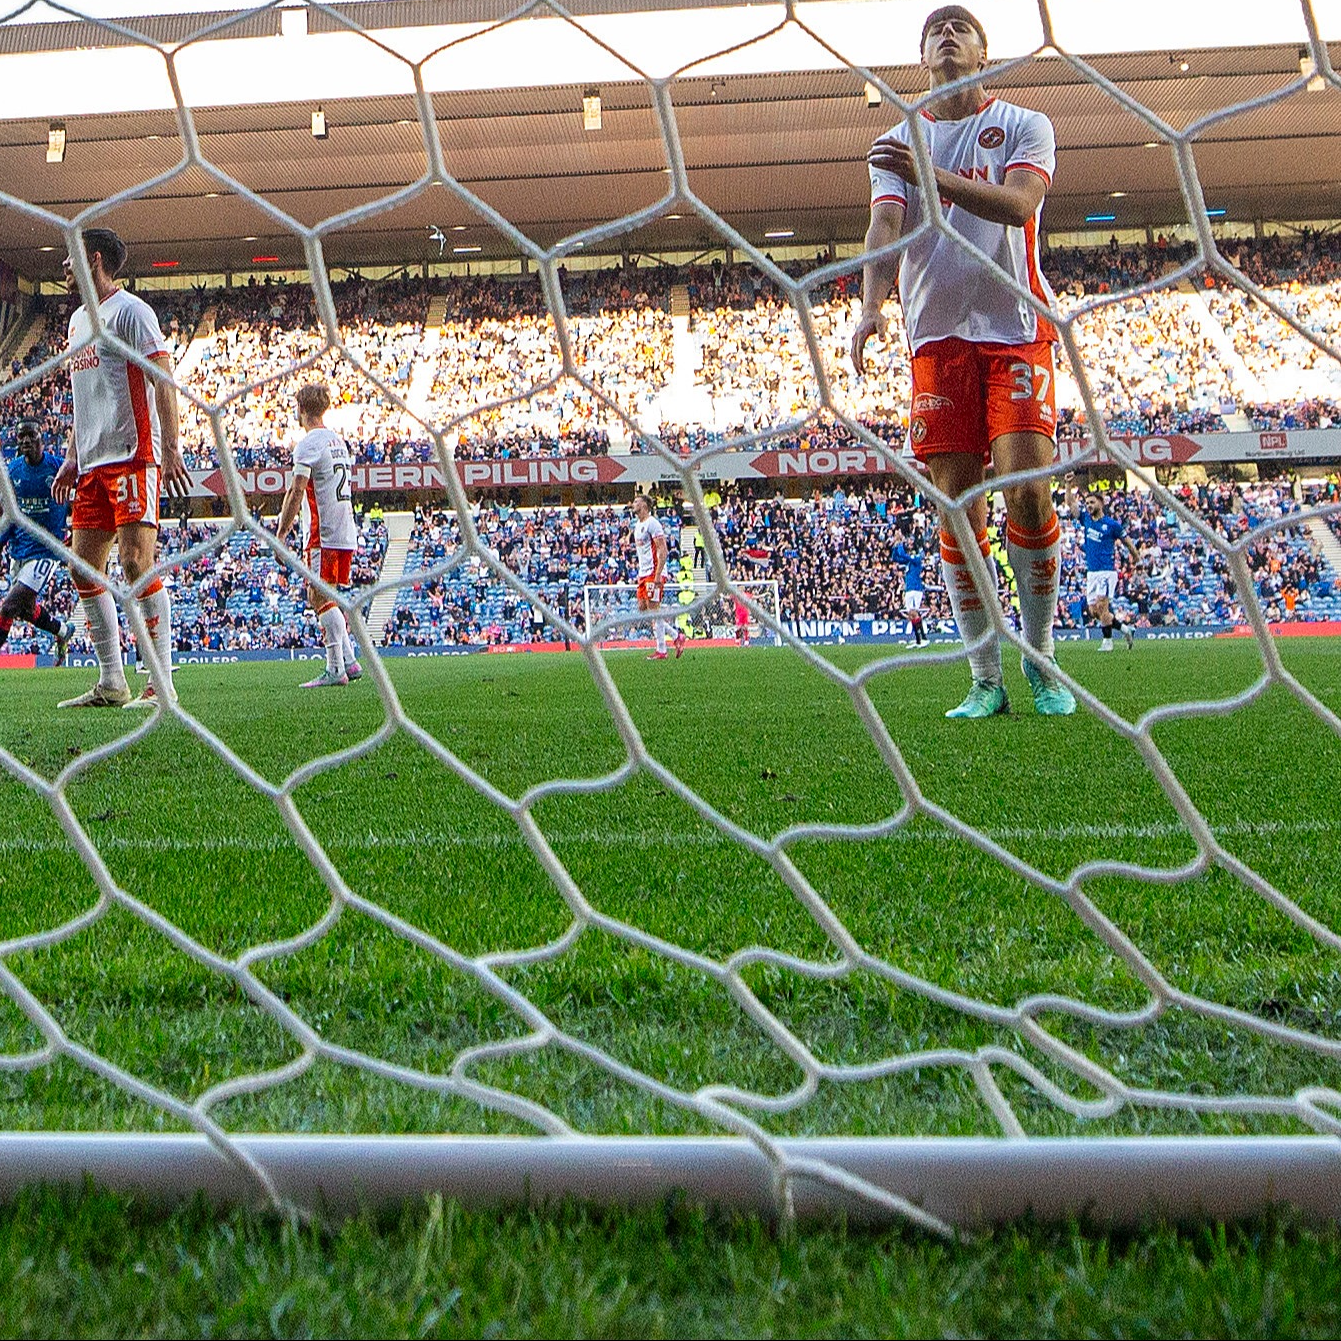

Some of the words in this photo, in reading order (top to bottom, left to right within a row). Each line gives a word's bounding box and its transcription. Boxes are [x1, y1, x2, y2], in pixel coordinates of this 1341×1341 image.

[1010, 362, 1050, 402] 37
[117, 473, 139, 502] 31
[236, 465, 449, 493] NOHERN
[464, 459, 599, 485] PILING
